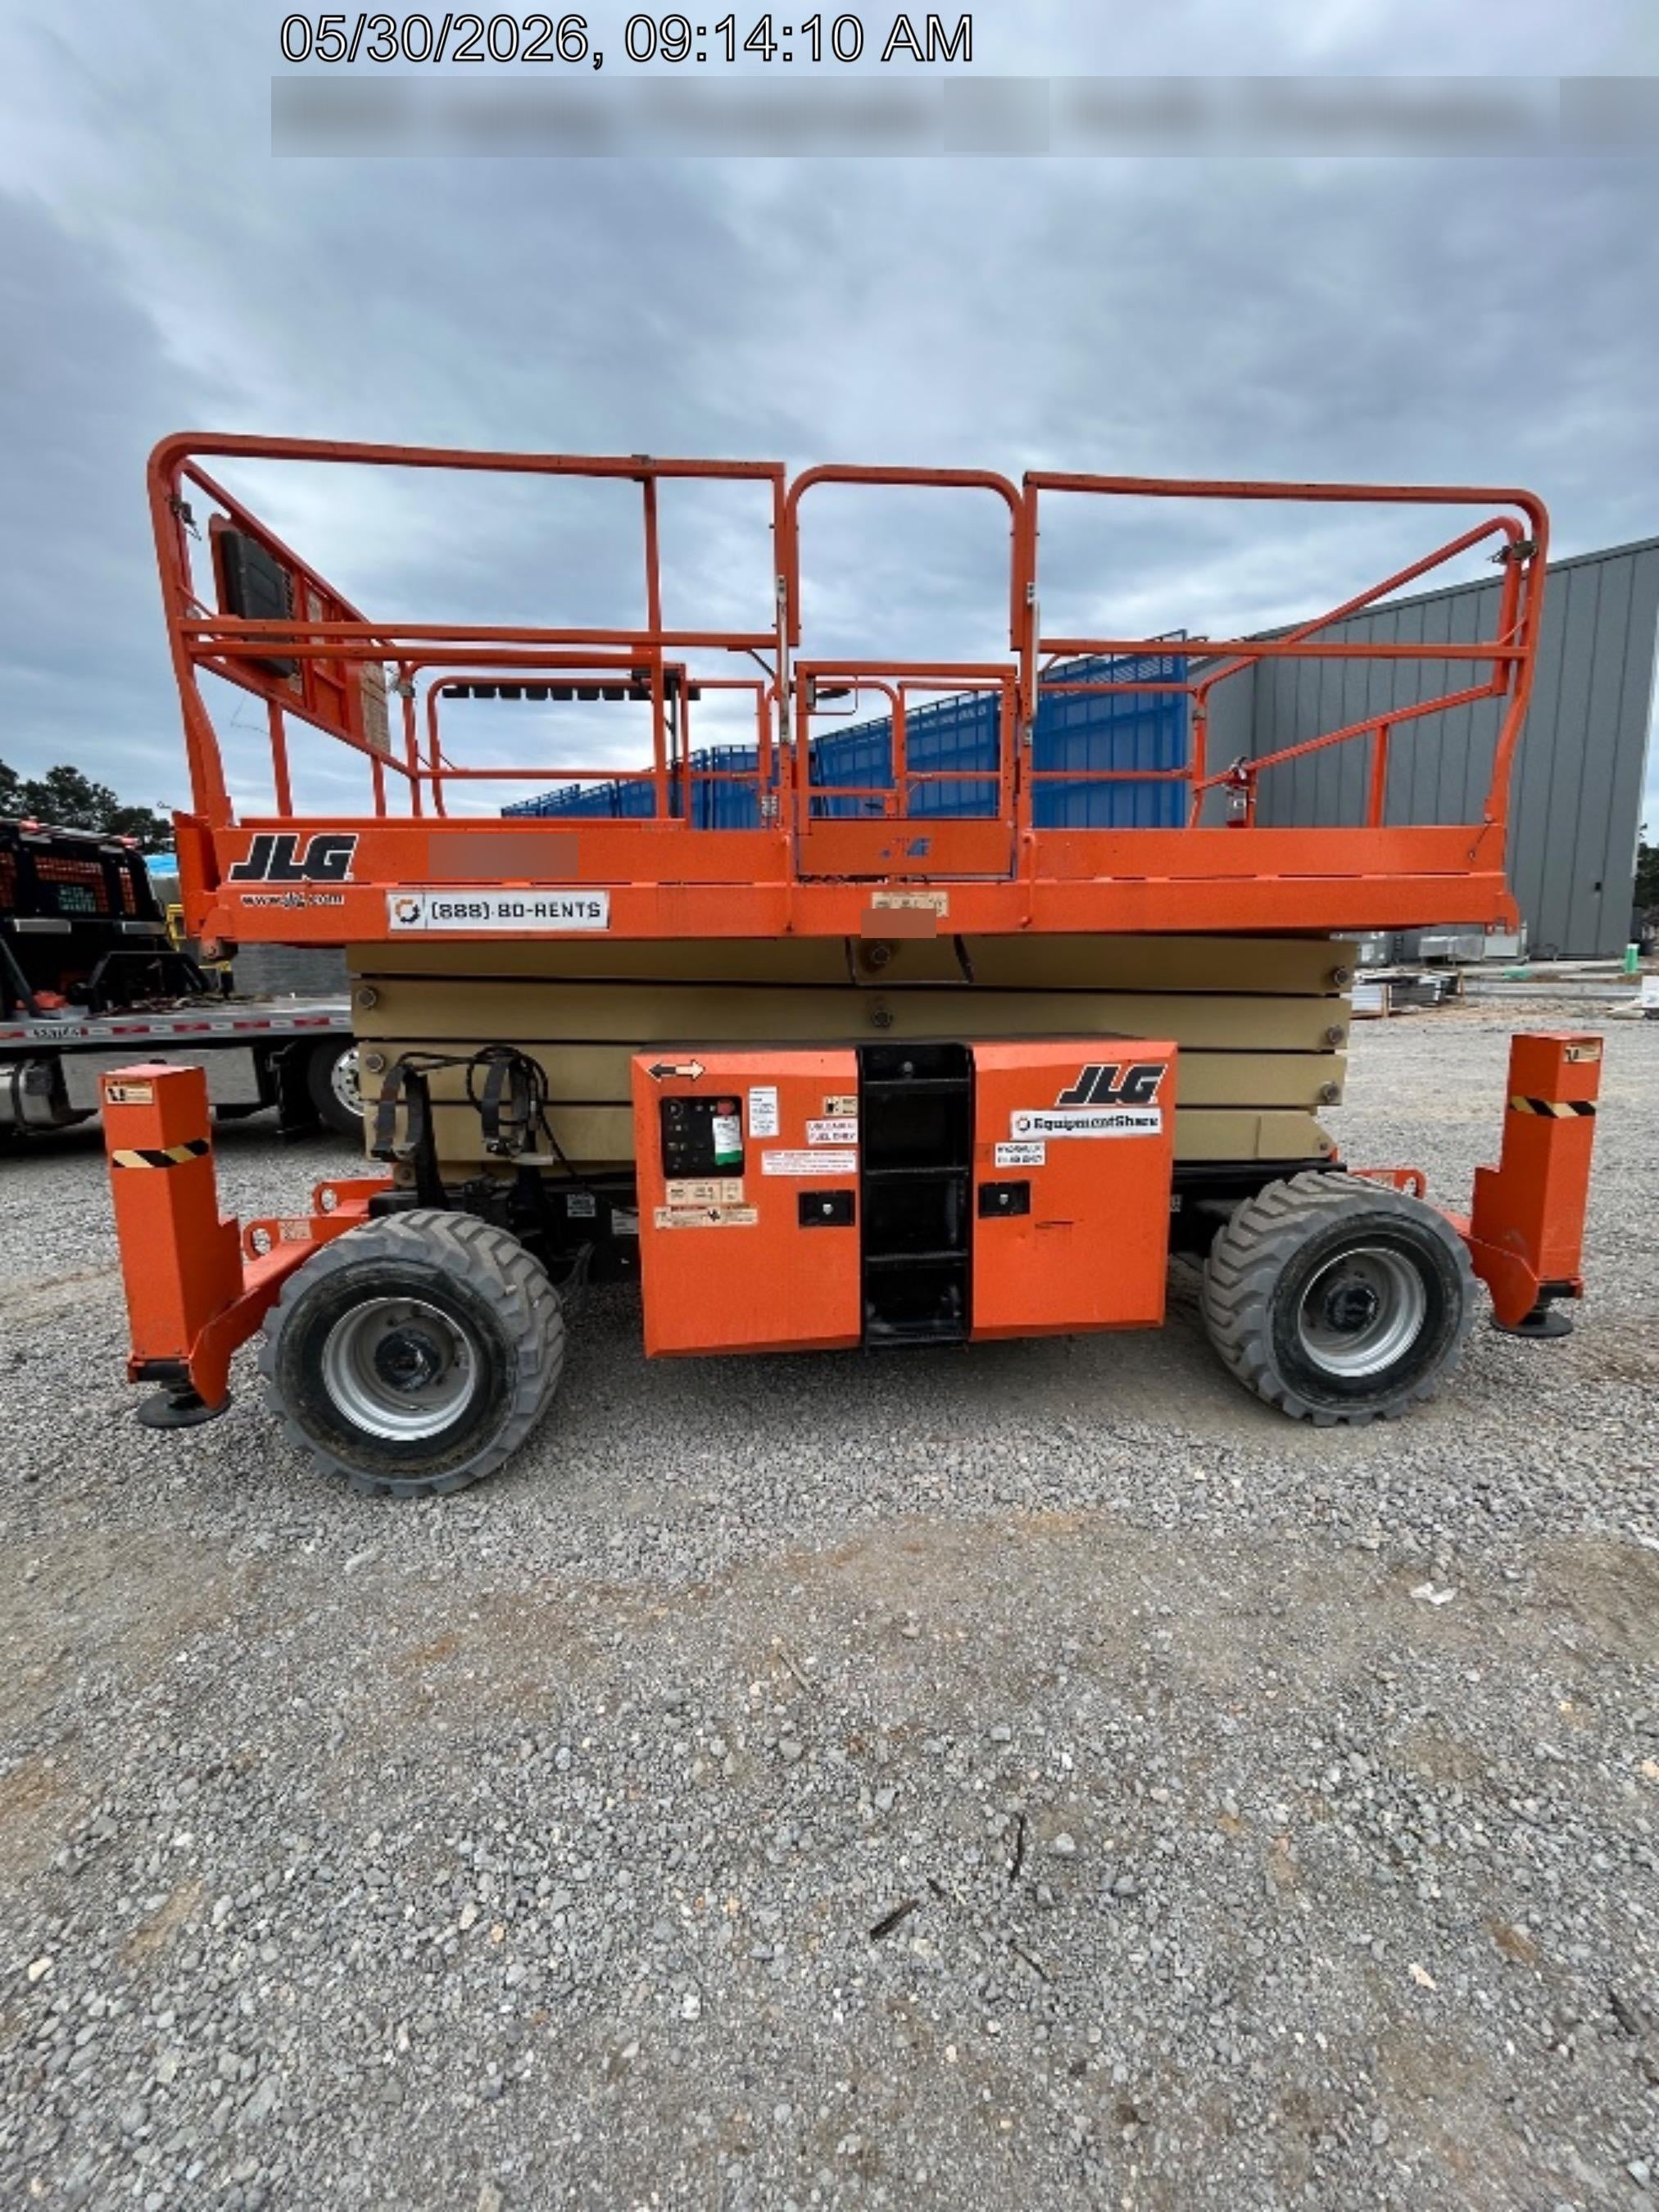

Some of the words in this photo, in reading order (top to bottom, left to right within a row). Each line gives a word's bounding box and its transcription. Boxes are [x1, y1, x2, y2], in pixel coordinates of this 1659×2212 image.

[228, 832, 359, 882] JLG
[431, 901, 490, 919] (888)
[1054, 1063, 1168, 1106] JLG
